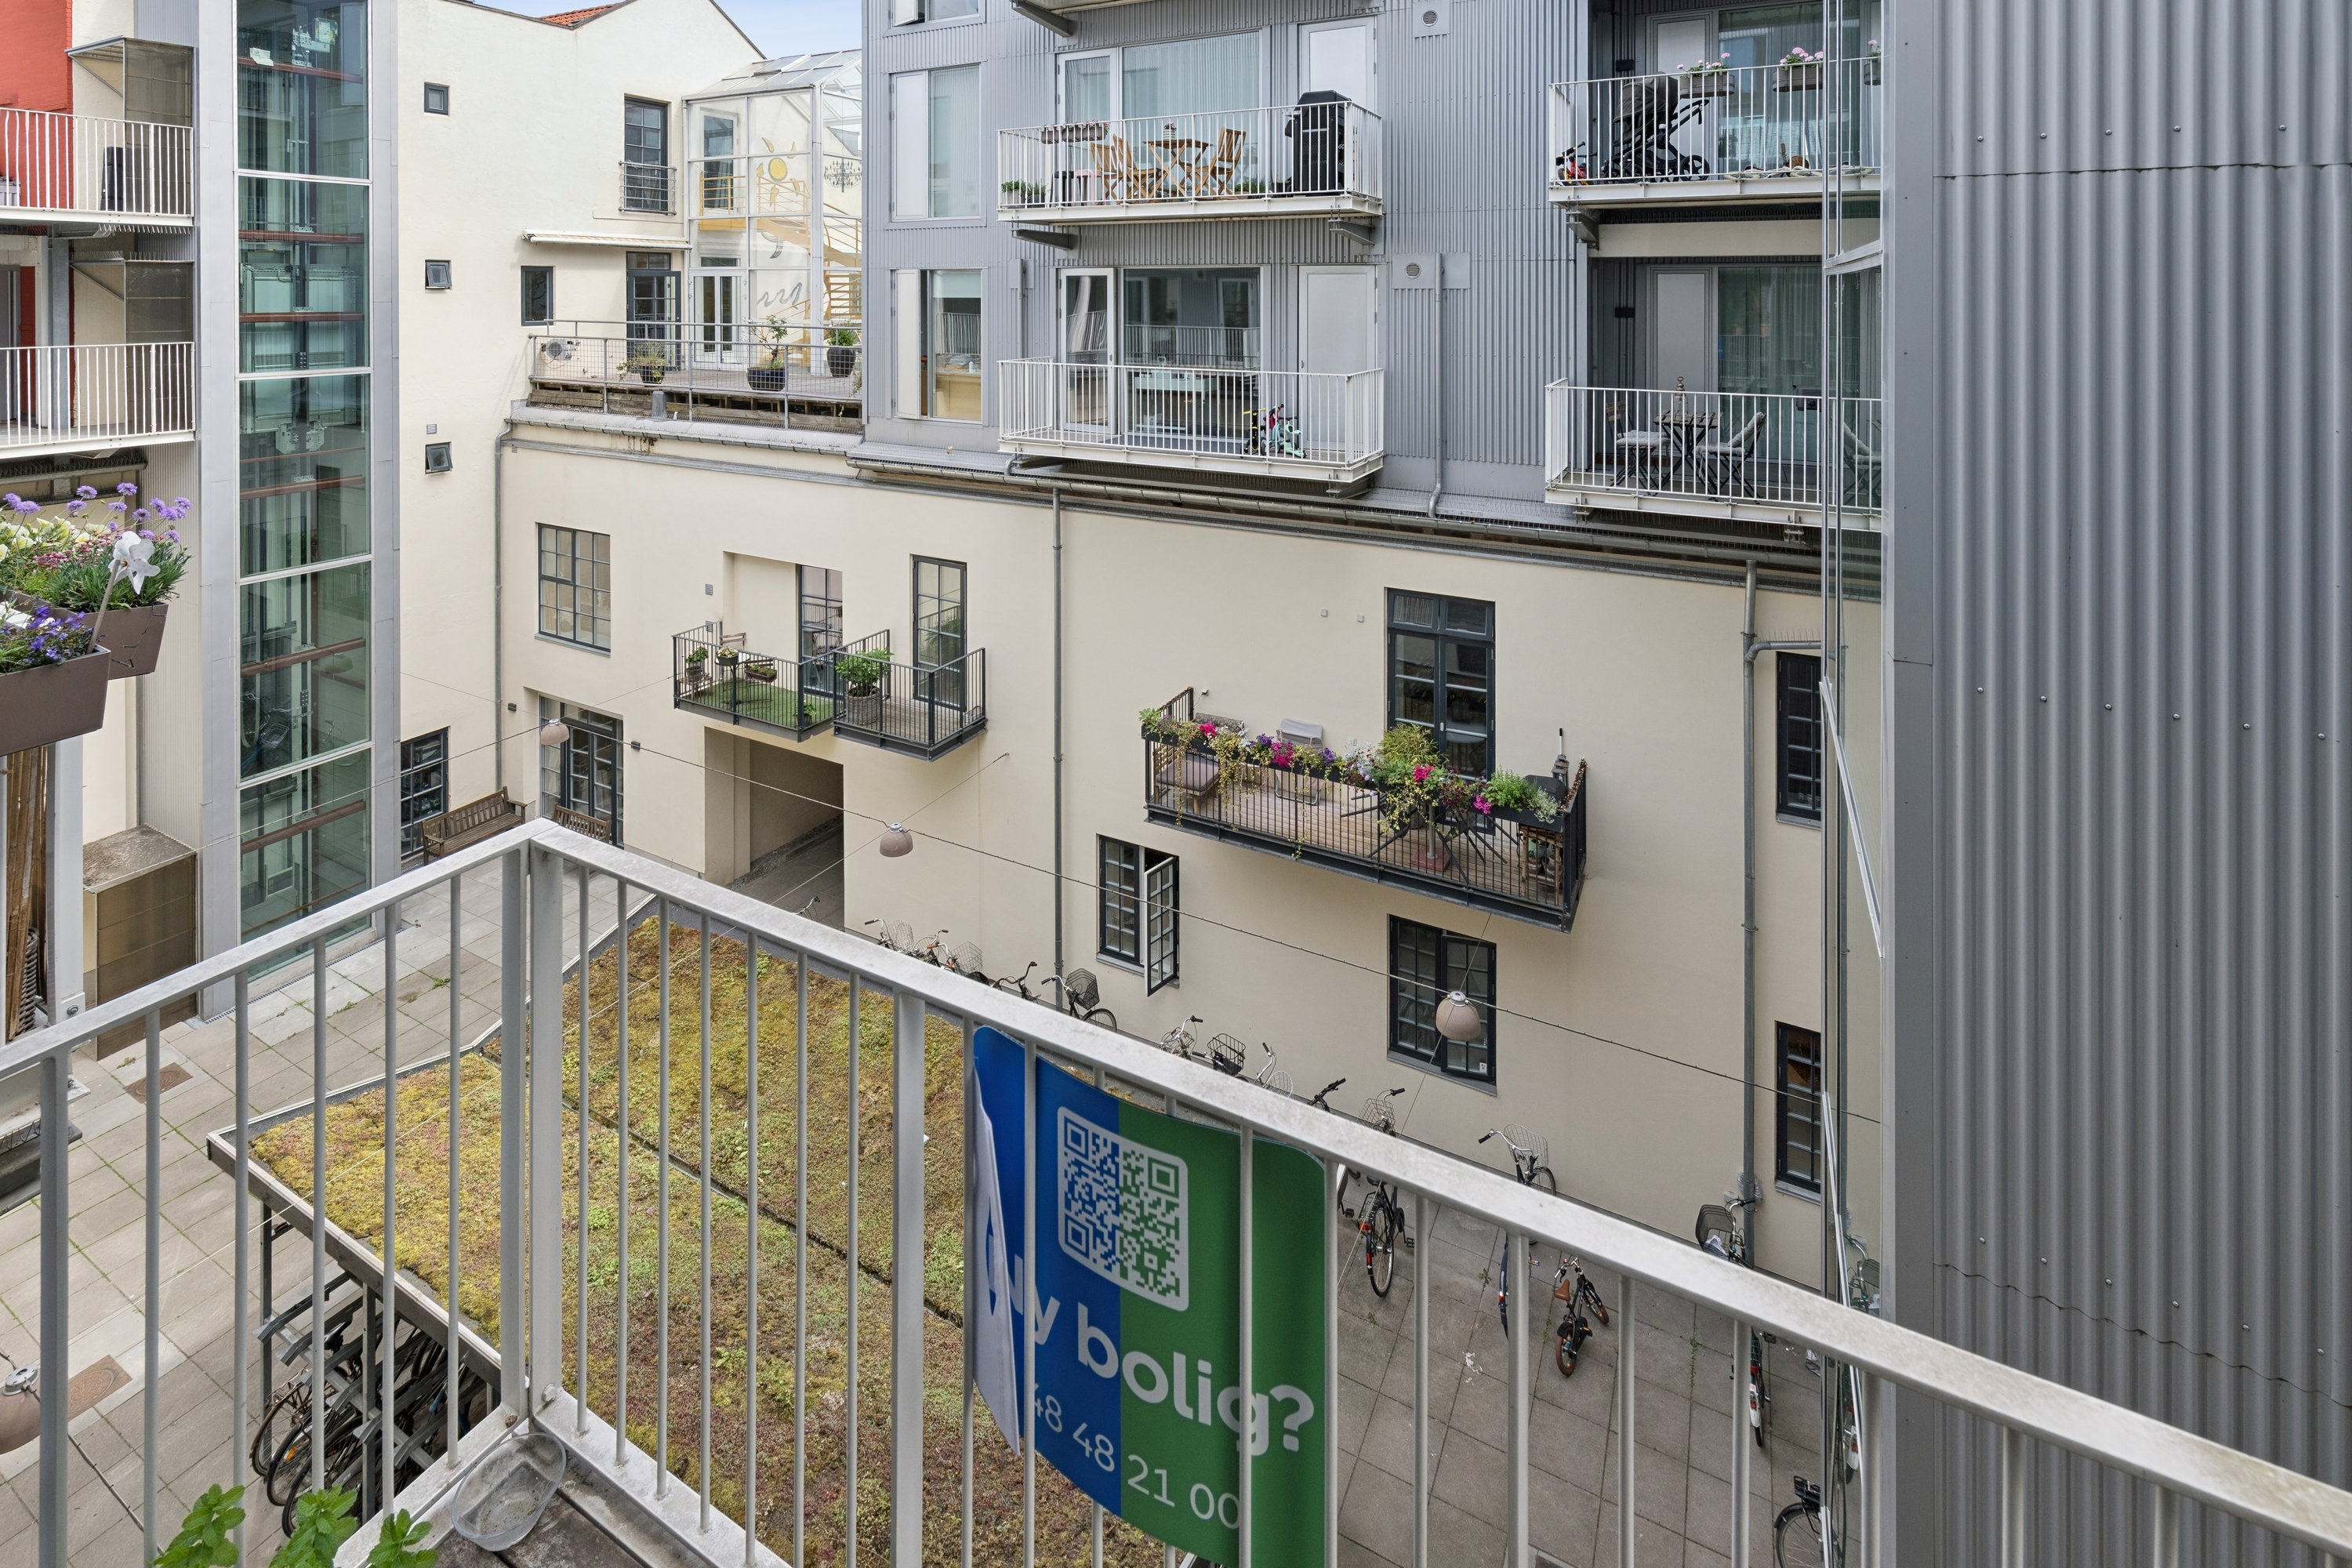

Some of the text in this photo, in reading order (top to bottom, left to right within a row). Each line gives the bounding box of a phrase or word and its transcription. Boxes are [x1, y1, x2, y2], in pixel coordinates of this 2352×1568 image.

[1077, 1301, 1315, 1457] bolig?
[1073, 1421, 1116, 1472] 48
[1127, 1454, 1175, 1508] 21
[1189, 1483, 1240, 1530] 00
